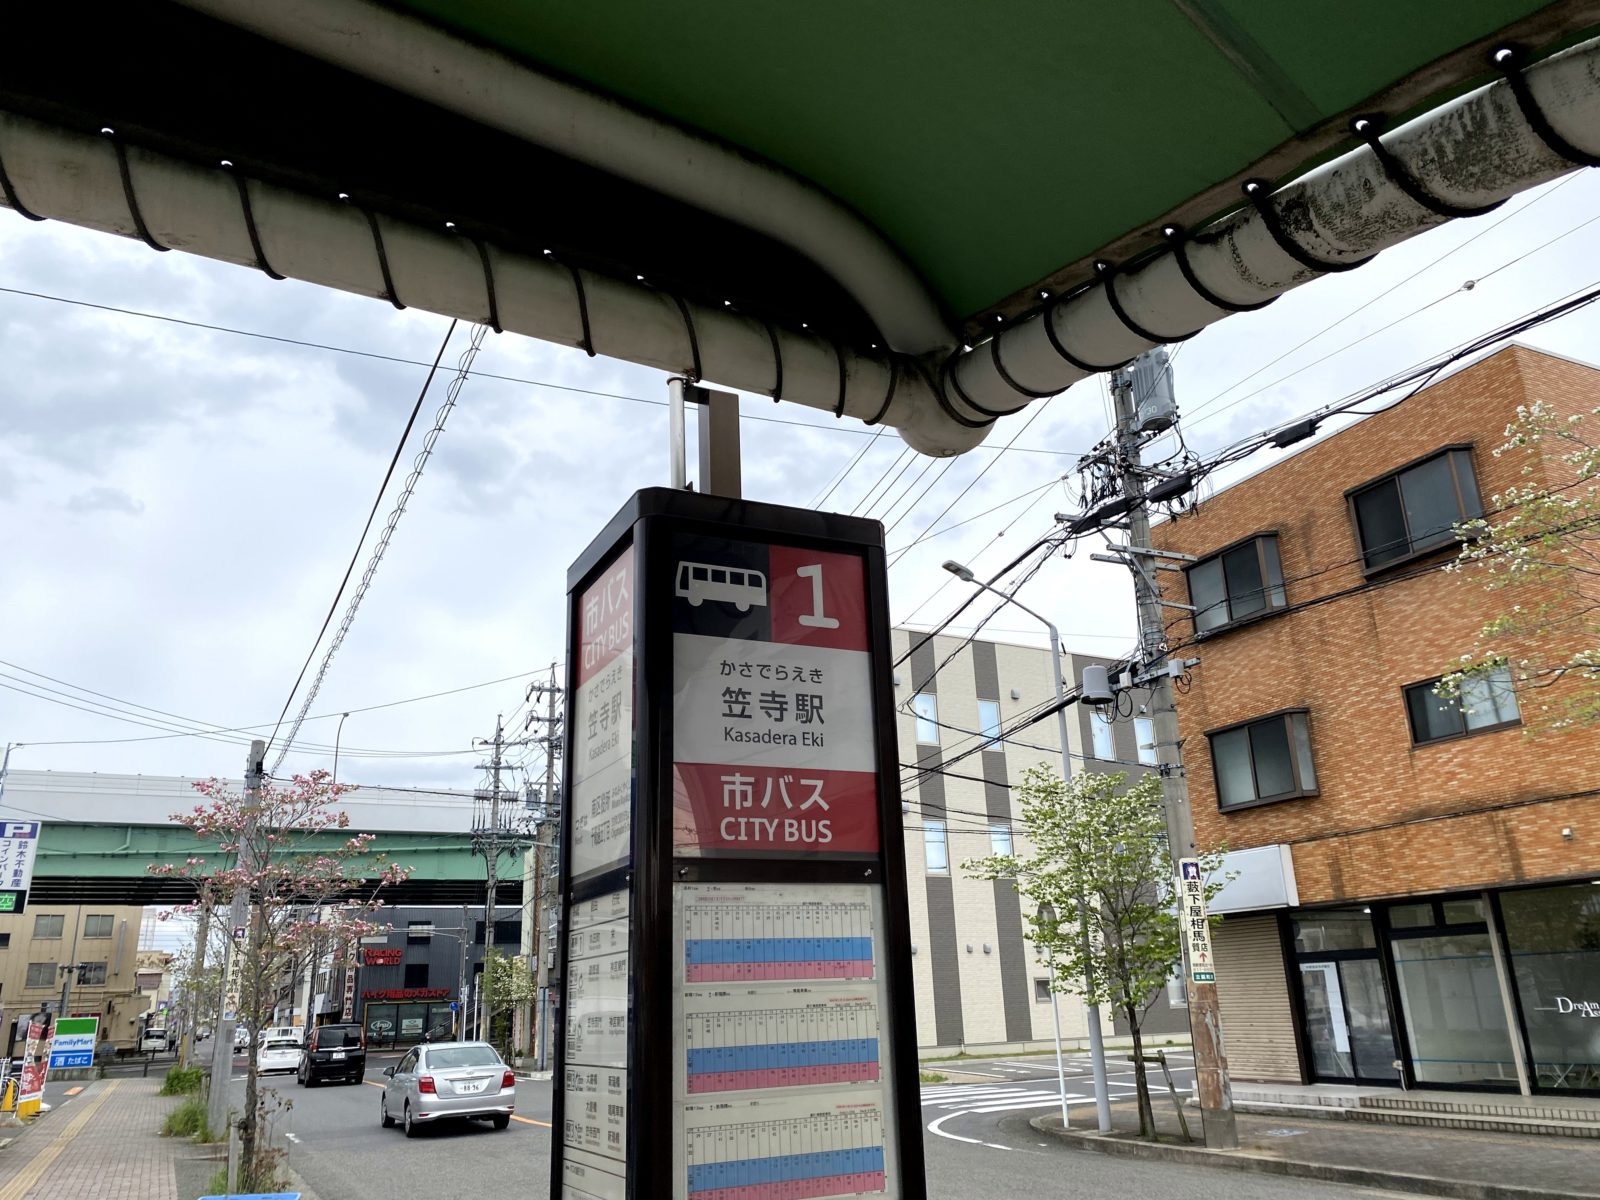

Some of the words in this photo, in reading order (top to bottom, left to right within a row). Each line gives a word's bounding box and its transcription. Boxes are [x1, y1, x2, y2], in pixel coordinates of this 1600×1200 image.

[585, 567, 629, 637] 市バス
[796, 563, 840, 629] 1
[585, 629, 607, 670] CITY
[608, 611, 629, 651] BUS
[588, 665, 623, 704] かさでらえき
[720, 659, 824, 684] かさでらえき
[587, 690, 622, 741] 笠寺駅
[721, 686, 825, 725] 笠寺駅
[588, 737, 611, 761] Kasadera
[611, 731, 619, 749] Eki
[724, 727, 798, 746] Kasadera
[802, 731, 824, 748] Eki
[720, 772, 830, 812] 市バス
[720, 817, 779, 842] CITY
[784, 819, 833, 843] BUS
[11, 840, 29, 888] 鈴木不動産
[1186, 881, 1206, 942] 藪下屋相馬
[364, 948, 402, 957] RACING
[54, 1038, 93, 1048] FamilyMart
[67, 1056, 88, 1066] たばこ
